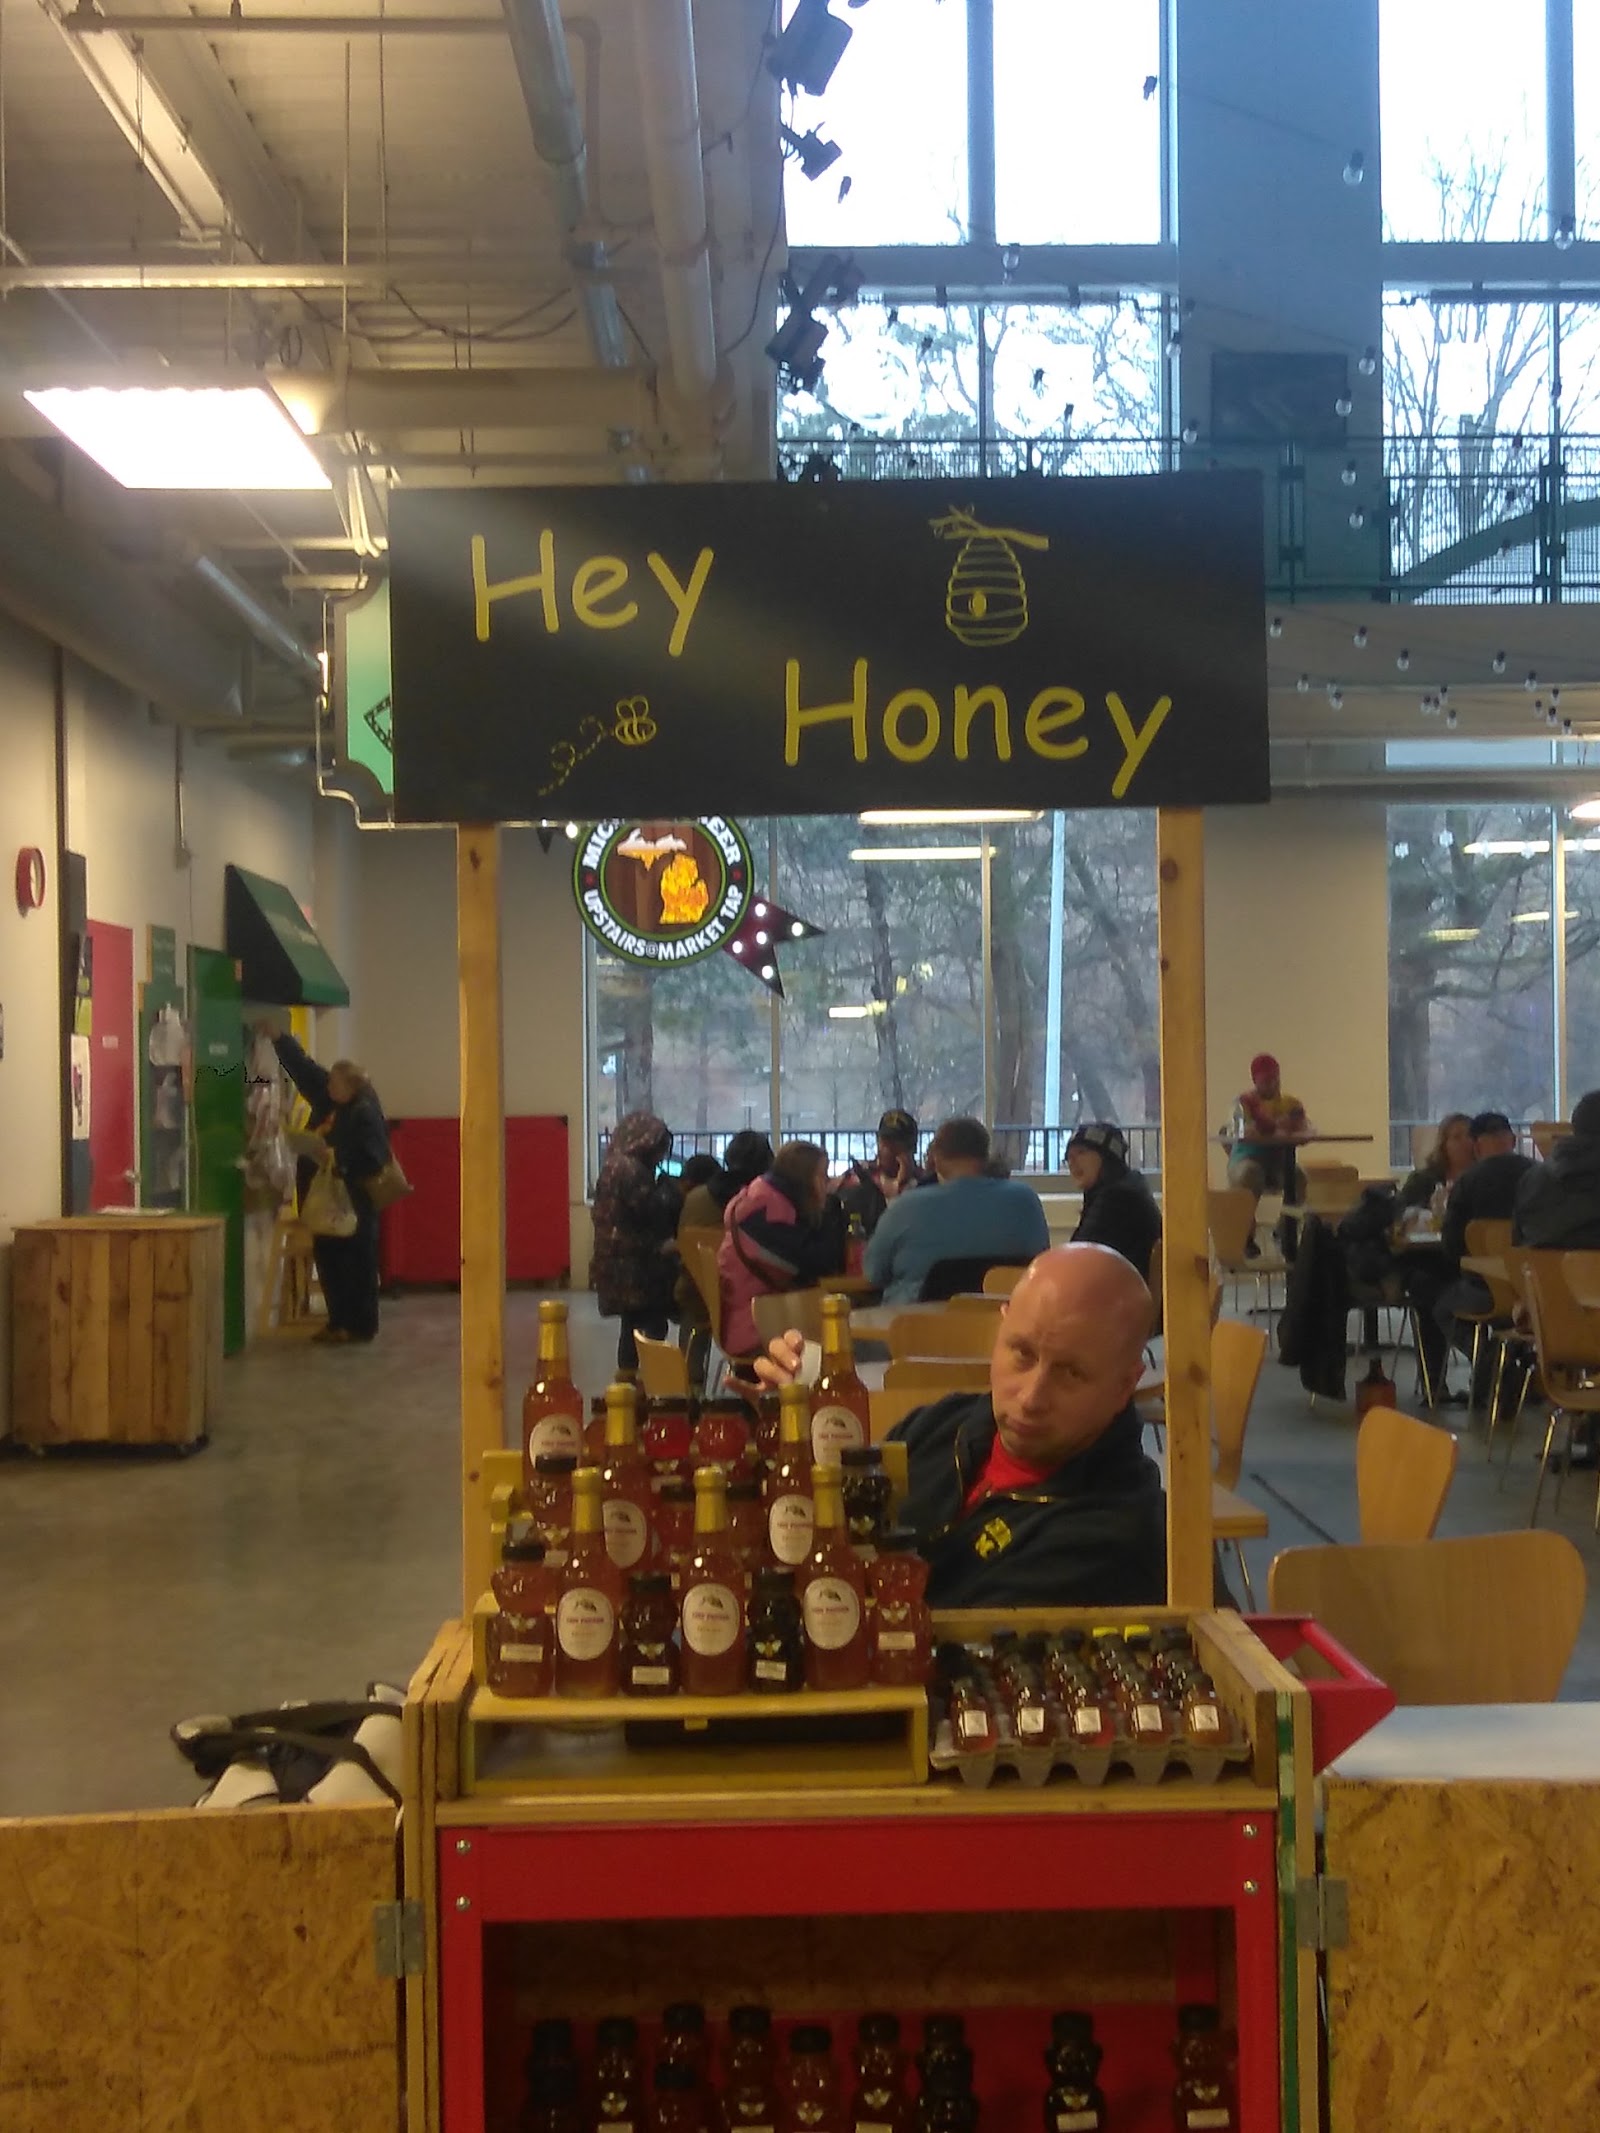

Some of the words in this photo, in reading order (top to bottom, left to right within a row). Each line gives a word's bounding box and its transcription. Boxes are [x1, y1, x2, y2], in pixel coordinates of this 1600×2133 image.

[472, 529, 714, 657] Hey
[785, 658, 1172, 799] Honey
[720, 884, 743, 920] TAP
